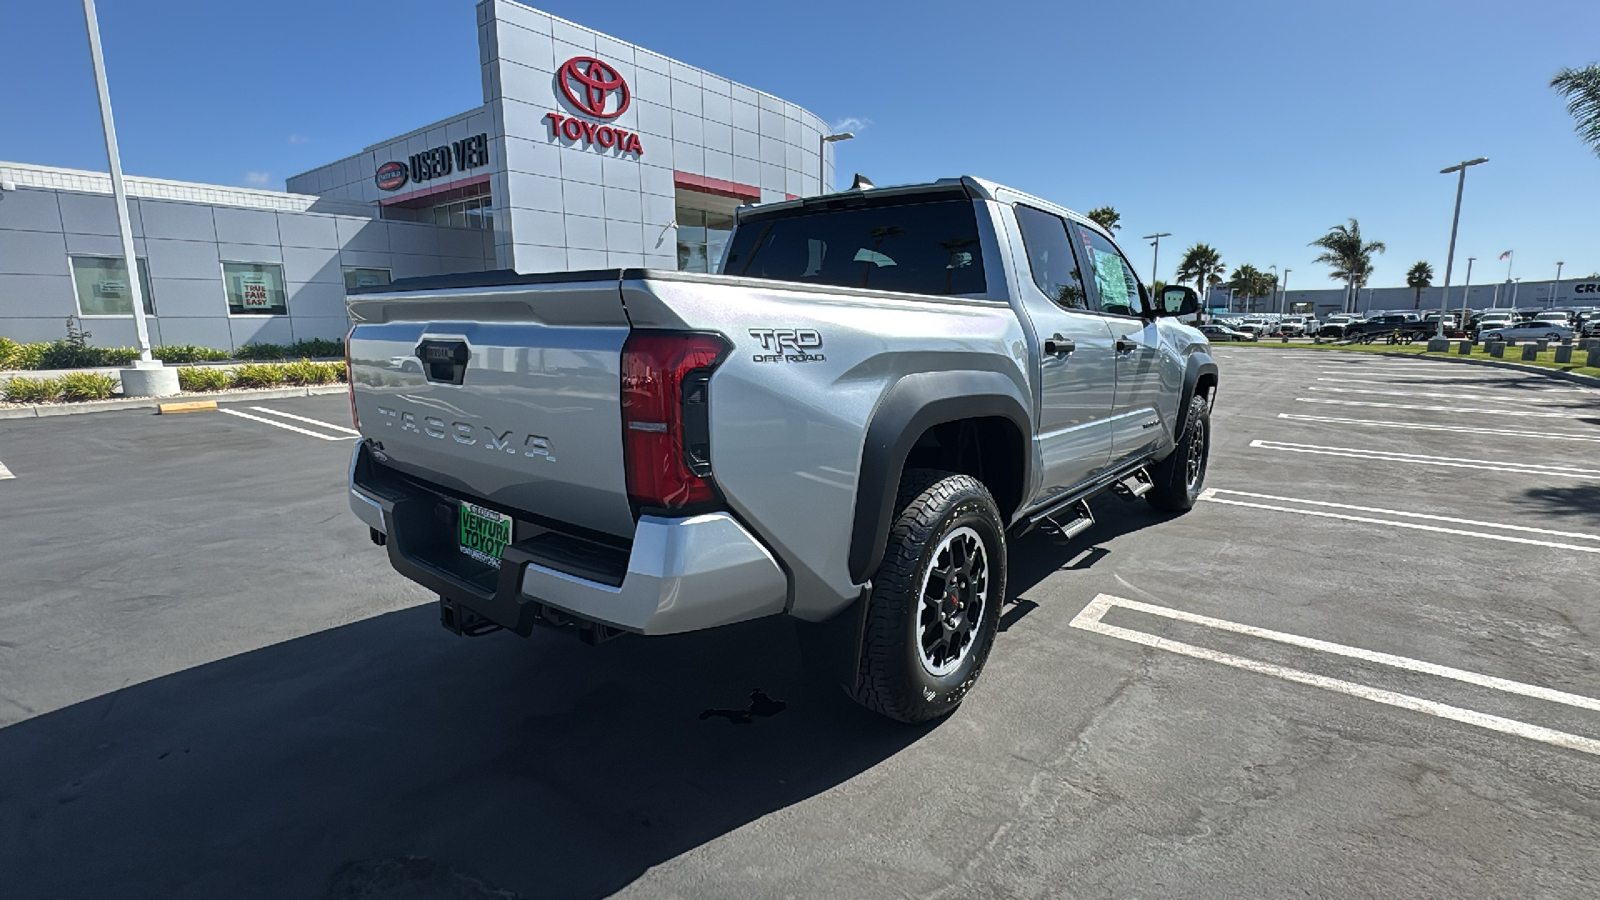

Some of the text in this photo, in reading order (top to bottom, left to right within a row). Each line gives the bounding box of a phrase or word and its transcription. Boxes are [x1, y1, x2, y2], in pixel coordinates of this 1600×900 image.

[547, 112, 644, 155] TOYOTA
[409, 133, 489, 183] USED VEH
[244, 284, 267, 292] TRUE
[244, 291, 267, 299] FAIR
[748, 328, 823, 353] TRD
[753, 354, 783, 363] OFF
[377, 406, 557, 463] TACOMA
[463, 511, 510, 544] VENTURA
[464, 528, 505, 559] TOYOT
